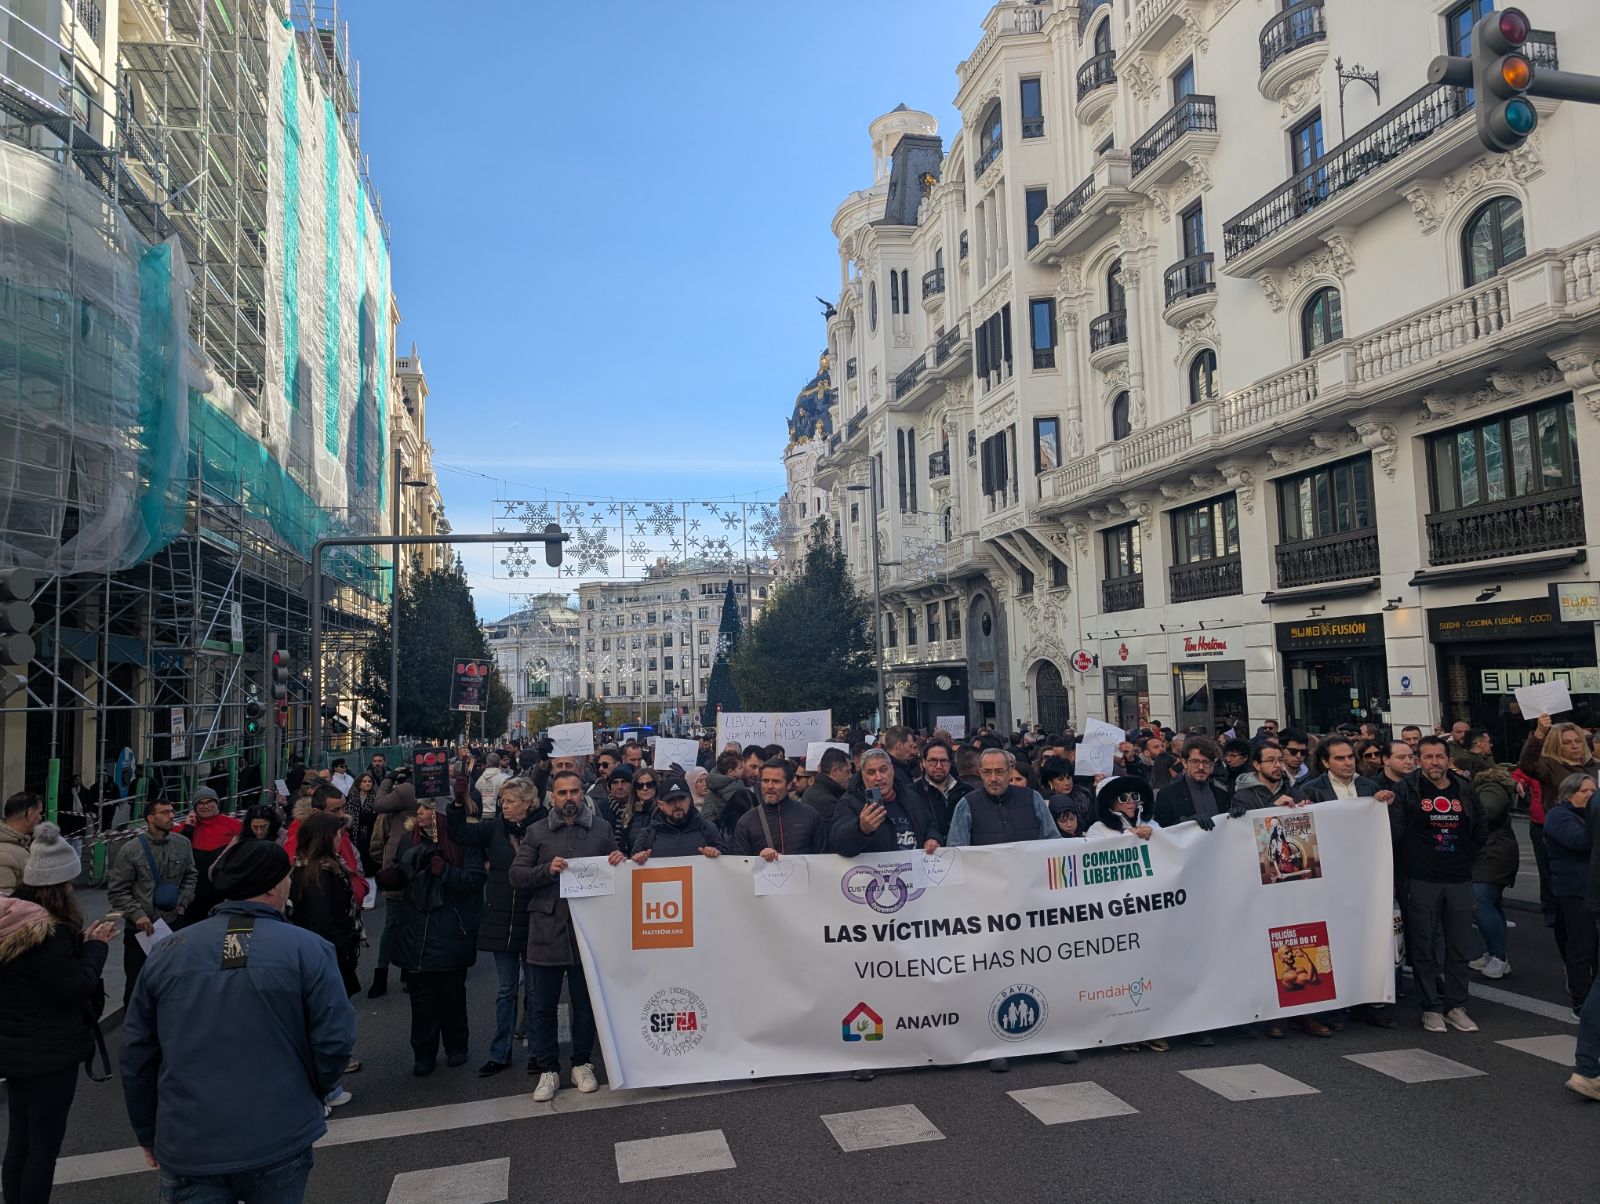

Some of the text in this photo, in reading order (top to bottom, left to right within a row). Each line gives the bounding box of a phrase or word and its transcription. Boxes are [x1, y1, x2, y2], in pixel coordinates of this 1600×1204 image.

[1332, 621, 1366, 635] FUSIÓN
[1439, 622, 1460, 630] SUSHI
[1466, 619, 1493, 628] COCINA
[1494, 614, 1522, 625] FUSIÓN
[1183, 636, 1197, 652] Tim
[725, 715, 755, 728] LLEVO
[758, 715, 767, 728] 4
[805, 716, 820, 727] SIN
[744, 731, 751, 740] A
[753, 729, 767, 739] MIS
[774, 729, 807, 741] HIJOS
[1421, 796, 1462, 813] SOS
[1082, 846, 1139, 868] COMANDO
[645, 901, 679, 920] HO
[824, 889, 1187, 943] LAS VÍCTIMAS NO TIENEN GÉNERO
[1299, 937, 1310, 945] DO
[1310, 935, 1317, 943] IT
[855, 932, 1141, 978] VIOLENCE HAS NO GENDER
[1001, 985, 1035, 998] DAVIA
[895, 1012, 960, 1030] ANAVID
